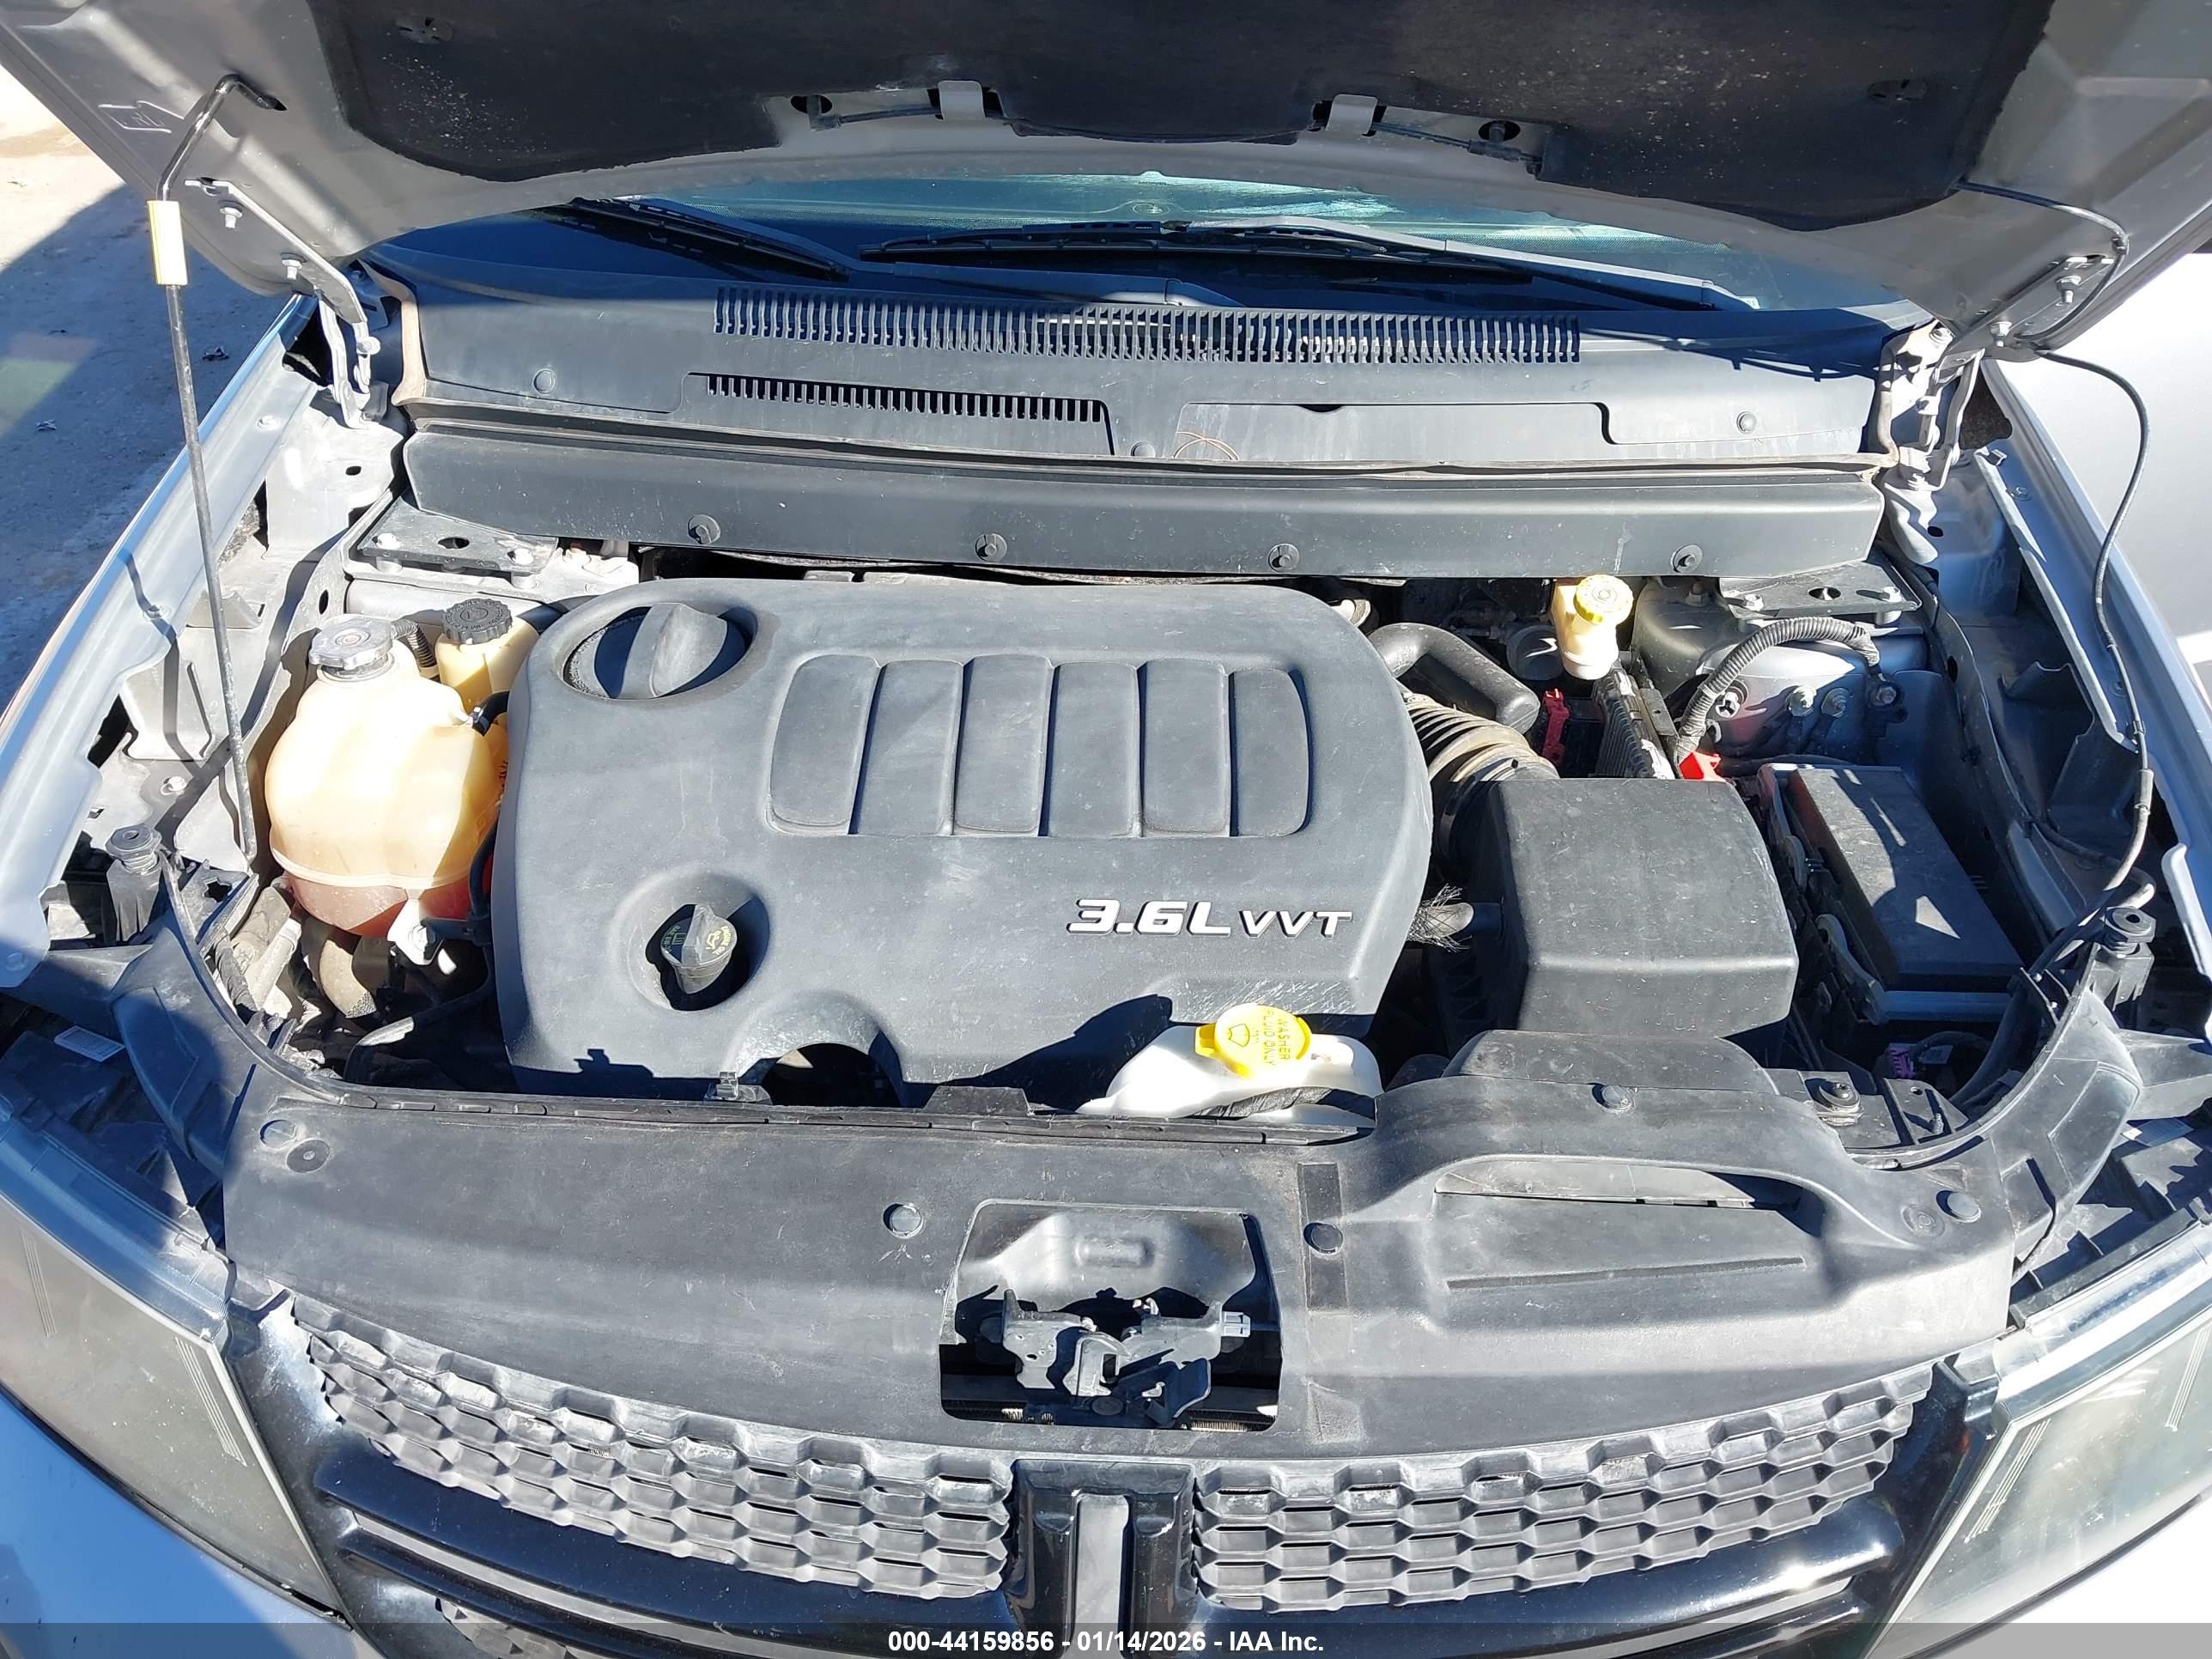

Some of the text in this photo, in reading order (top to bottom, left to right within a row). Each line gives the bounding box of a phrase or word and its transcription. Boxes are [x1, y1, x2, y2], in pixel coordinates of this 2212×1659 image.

[1066, 899, 1353, 939] 3.6L VVT
[712, 926, 732, 956] ENGINE OIL
[1277, 1018, 1291, 1060] WASHER
